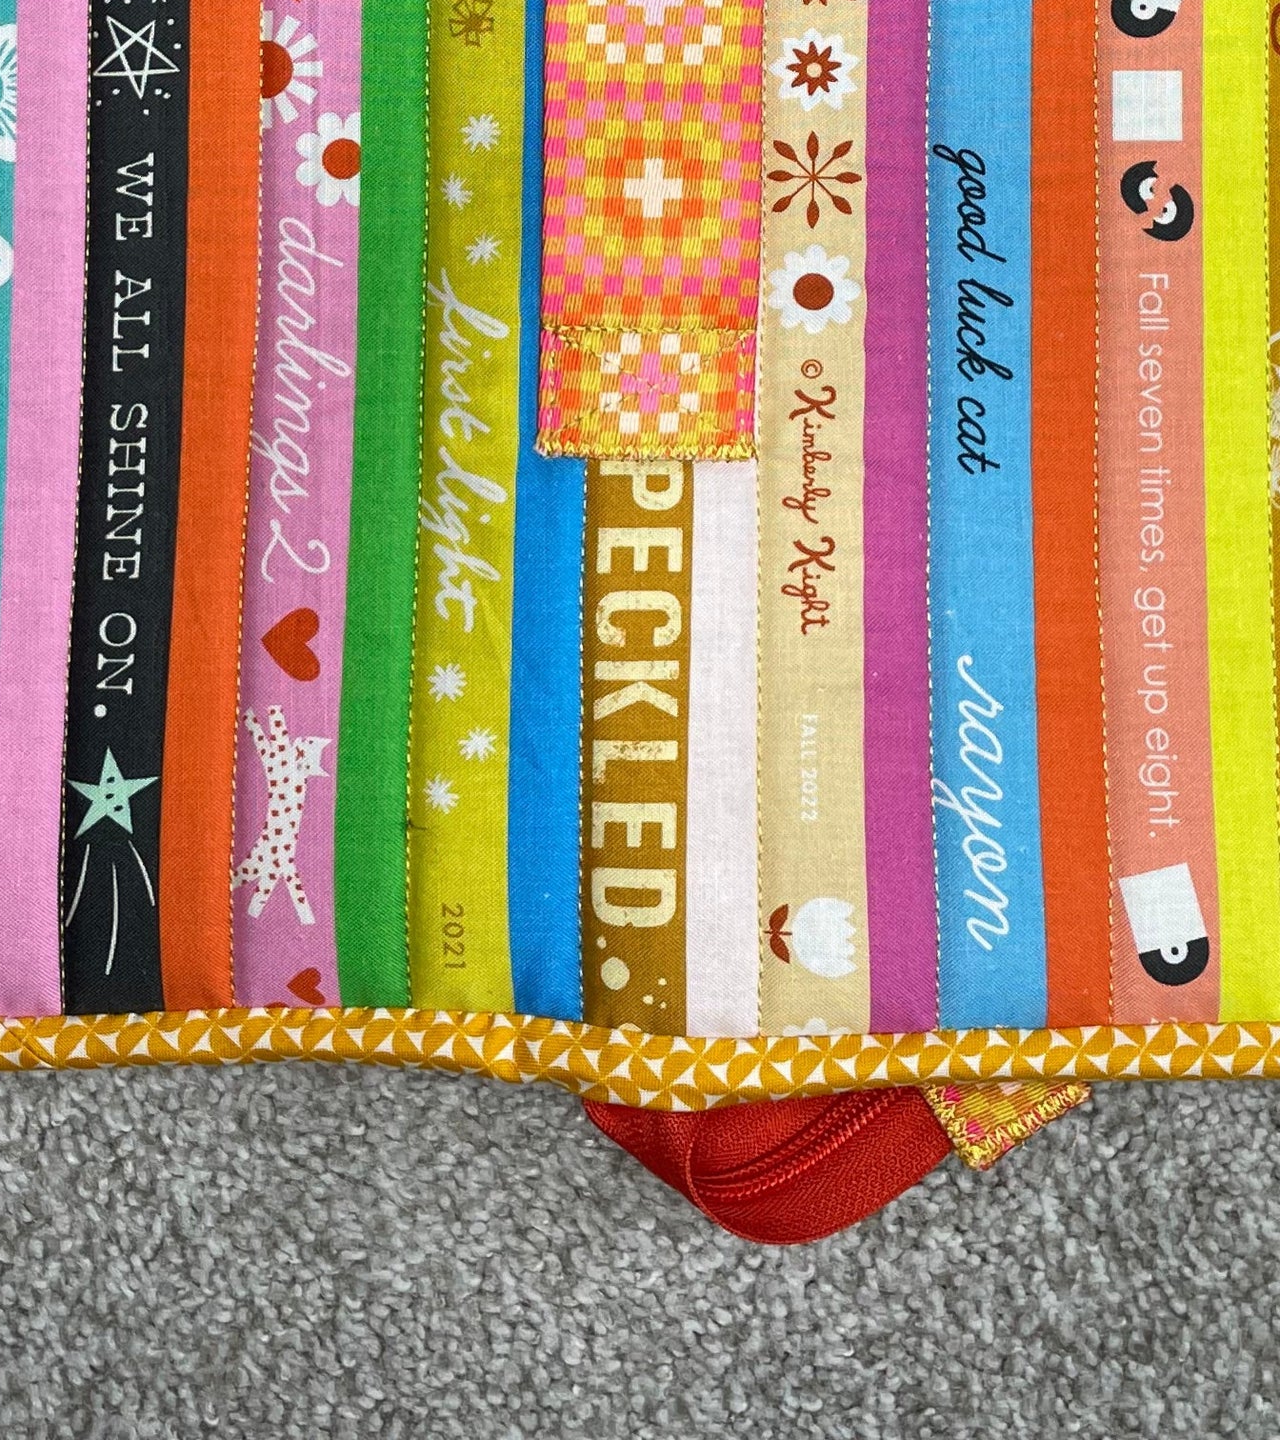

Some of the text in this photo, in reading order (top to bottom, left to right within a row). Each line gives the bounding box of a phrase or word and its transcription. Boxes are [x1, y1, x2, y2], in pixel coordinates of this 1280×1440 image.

[114, 152, 154, 241] WE
[111, 268, 154, 372] ALL
[932, 144, 1014, 476] good luck cat
[251, 217, 351, 585] darlings 2
[419, 268, 509, 635] first light
[789, 386, 836, 526] Kimberly
[101, 404, 148, 582] SHINE
[1134, 272, 1180, 838] Fall seven times, get up eight.
[781, 537, 836, 635] Kight
[800, 713, 819, 821] FALL 2022
[931, 655, 1011, 951] rayon
[441, 904, 465, 971] 2021
